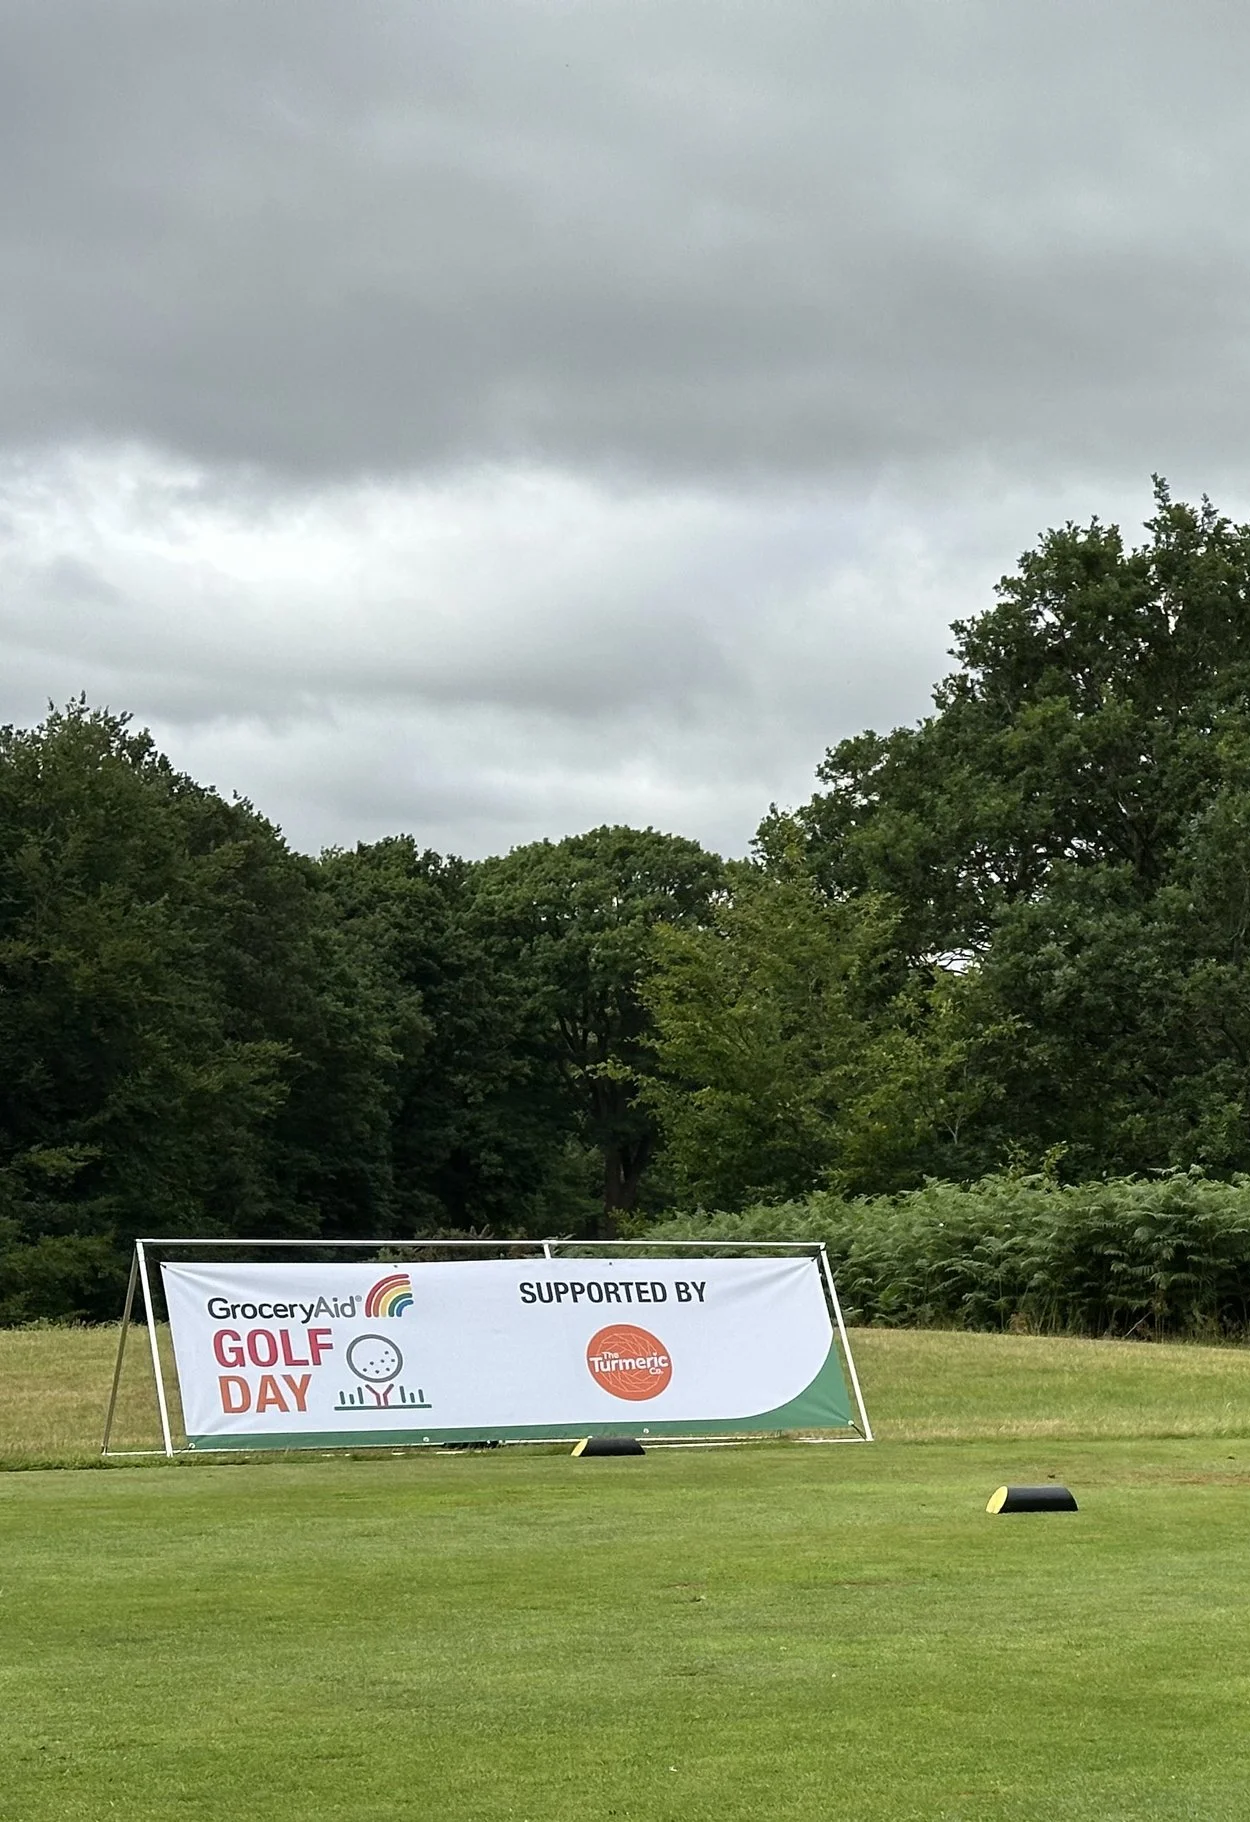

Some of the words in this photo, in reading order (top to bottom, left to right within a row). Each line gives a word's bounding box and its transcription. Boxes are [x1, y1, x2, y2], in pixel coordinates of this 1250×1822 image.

[519, 1281, 668, 1304] SUPPORTED
[674, 1281, 707, 1303] BY
[213, 1328, 334, 1368] GOLF
[601, 1351, 620, 1360] The
[588, 1351, 669, 1373] Turmeric
[648, 1367, 665, 1375] Co.
[218, 1373, 312, 1414] DAY
